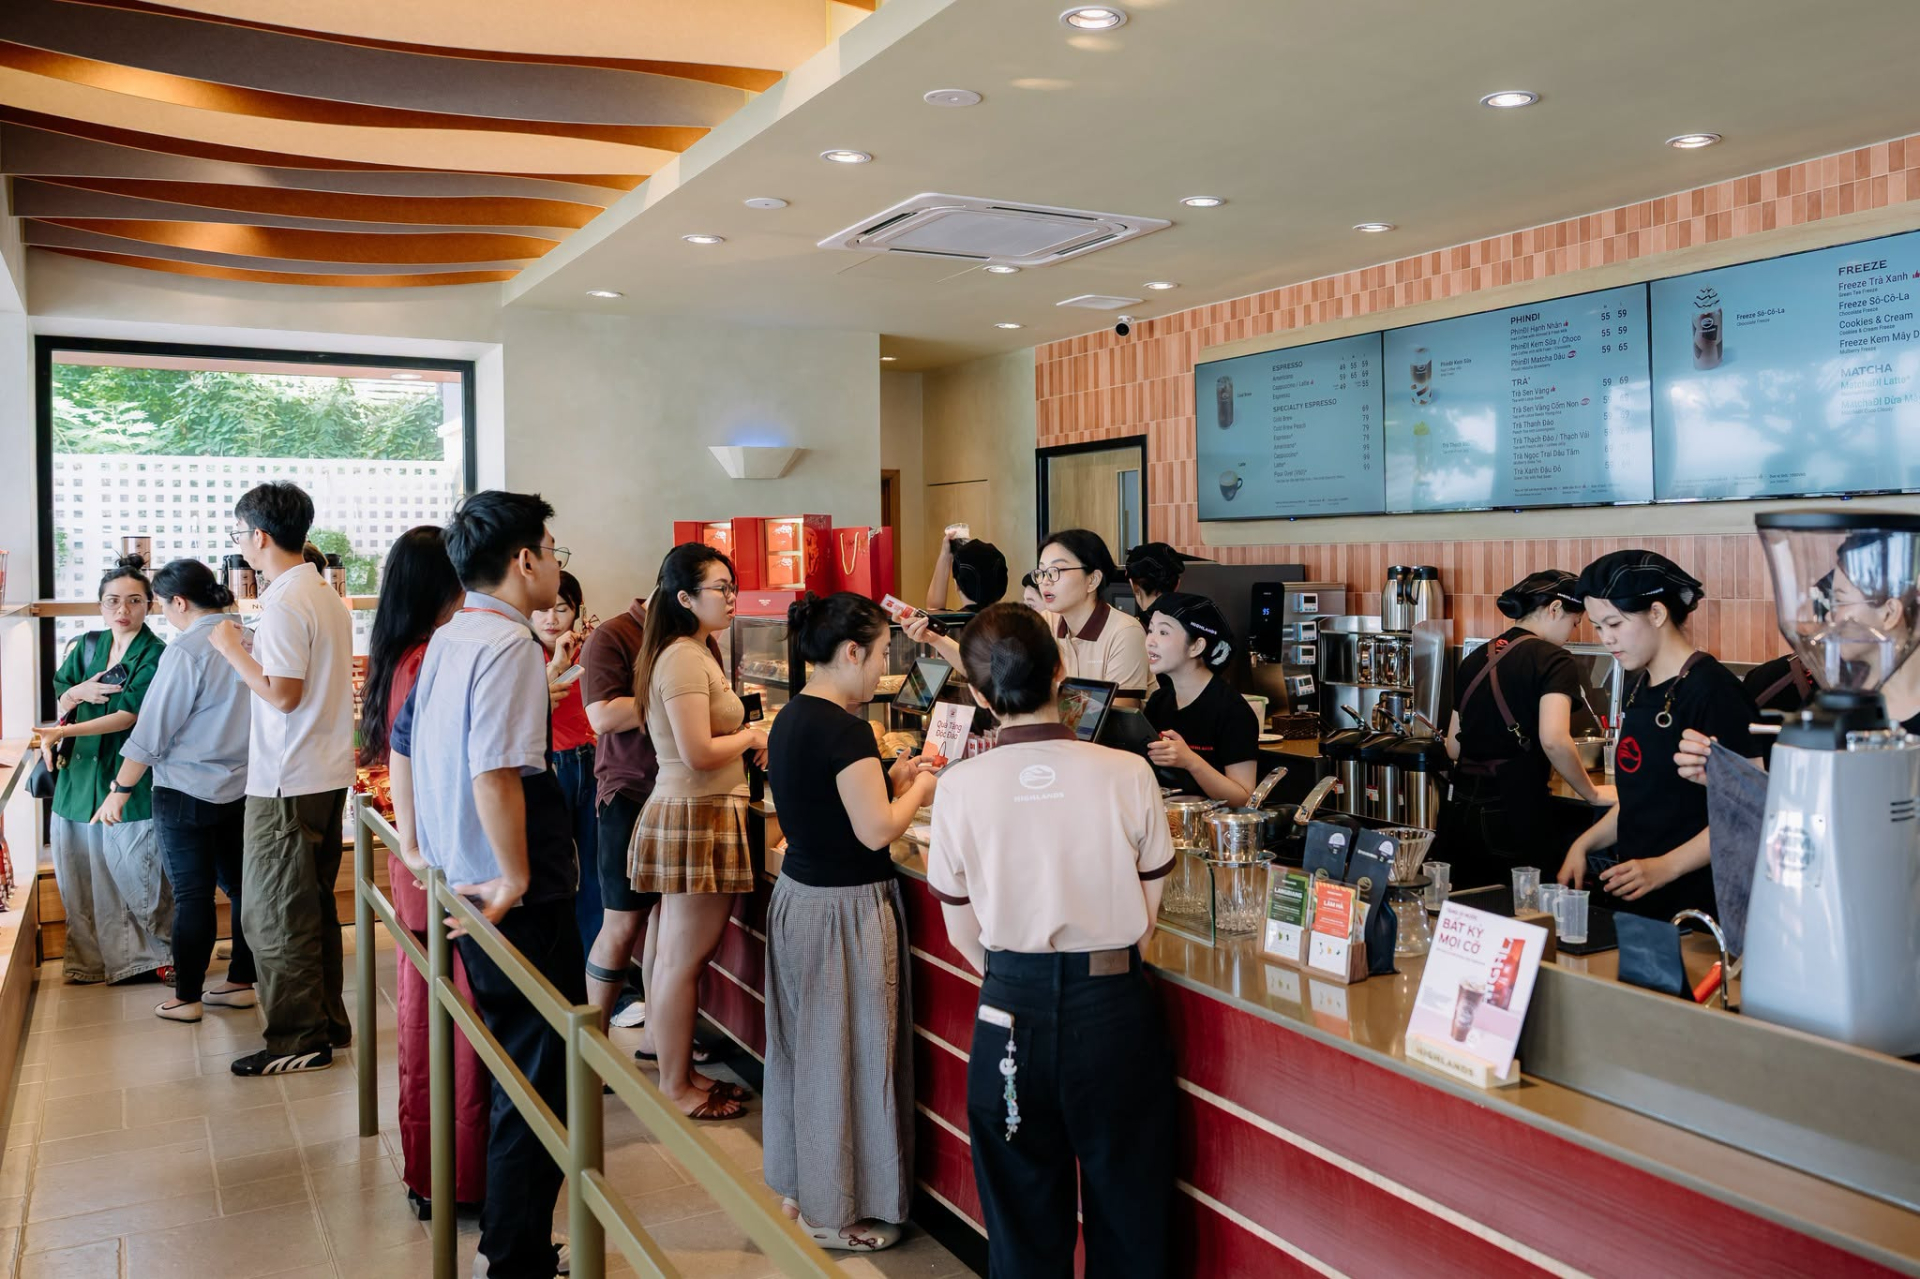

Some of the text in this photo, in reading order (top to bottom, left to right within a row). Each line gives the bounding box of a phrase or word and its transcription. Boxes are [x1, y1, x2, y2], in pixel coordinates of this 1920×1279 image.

[1838, 260, 1887, 276] FREEZE
[1838, 272, 1908, 291] Freeze Trà Xanh
[1839, 293, 1910, 310] Freeze Sô-Cô-La
[1510, 313, 1540, 324] PHINĐI
[1601, 309, 1627, 321] 55 59
[1839, 312, 1913, 329] Cookies & Cream
[1530, 323, 1545, 333] Hạnh
[1602, 326, 1627, 337] 55 59
[1510, 343, 1530, 352] PhinĐI
[1562, 335, 1581, 343] Choco
[1840, 338, 1868, 348] Freeze
[1870, 335, 1890, 344] Kem
[1892, 332, 1911, 342] Mây
[1602, 343, 1628, 353] 59 65
[1531, 355, 1552, 364] Matcha
[1272, 361, 1303, 372] ESPRESSO
[1841, 363, 1892, 377] MATCHA
[1602, 376, 1628, 386] 59 69
[1512, 389, 1521, 397] Trà
[1535, 386, 1549, 395] Vàng
[1273, 398, 1337, 413] SPECIALTY ESPRESSO
[1512, 406, 1521, 414] Trà
[1535, 403, 1550, 412] Vàng
[1603, 412, 1612, 420] 59
[1524, 435, 1542, 444] Thạch
[1560, 432, 1578, 440] Thạch
[1524, 451, 1539, 460] Ngọc
[1014, 792, 1064, 802] HIGHLANDS
[1442, 917, 1466, 933] BẤT
[1439, 932, 1461, 949] MỌI
